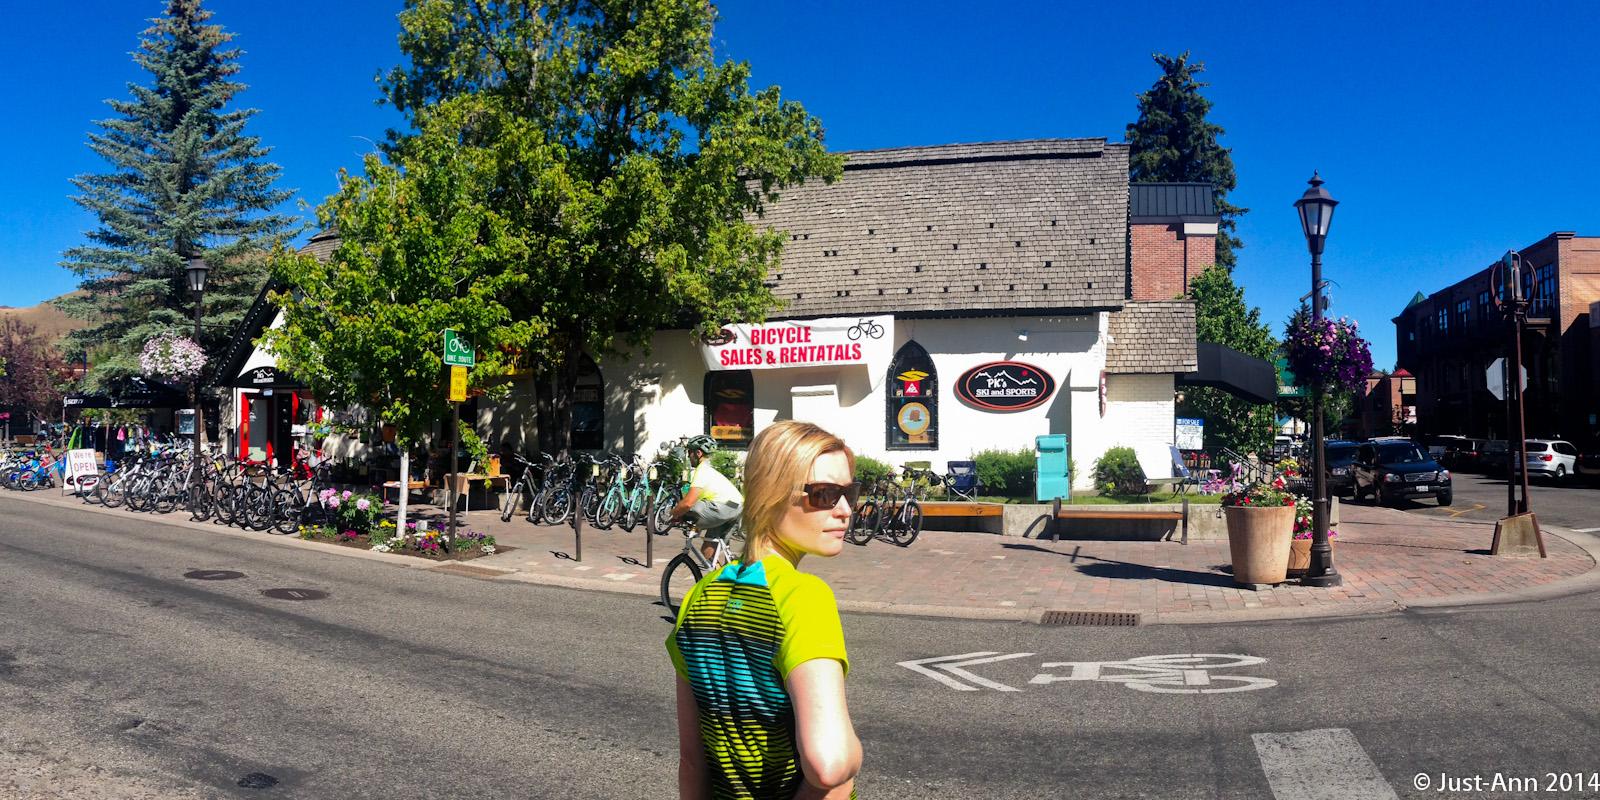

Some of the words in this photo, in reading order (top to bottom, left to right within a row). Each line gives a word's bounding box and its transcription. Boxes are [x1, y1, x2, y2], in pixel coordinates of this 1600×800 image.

[750, 326, 811, 345] BICYCLE
[720, 348, 762, 366] SALES
[766, 350, 776, 364] &
[780, 343, 862, 364] RENTATALS
[986, 378, 1007, 388] PK's
[976, 388, 989, 396] SKI
[990, 388, 1005, 396] and
[1006, 388, 1037, 396] SPORTS
[73, 462, 96, 472] OPEN
